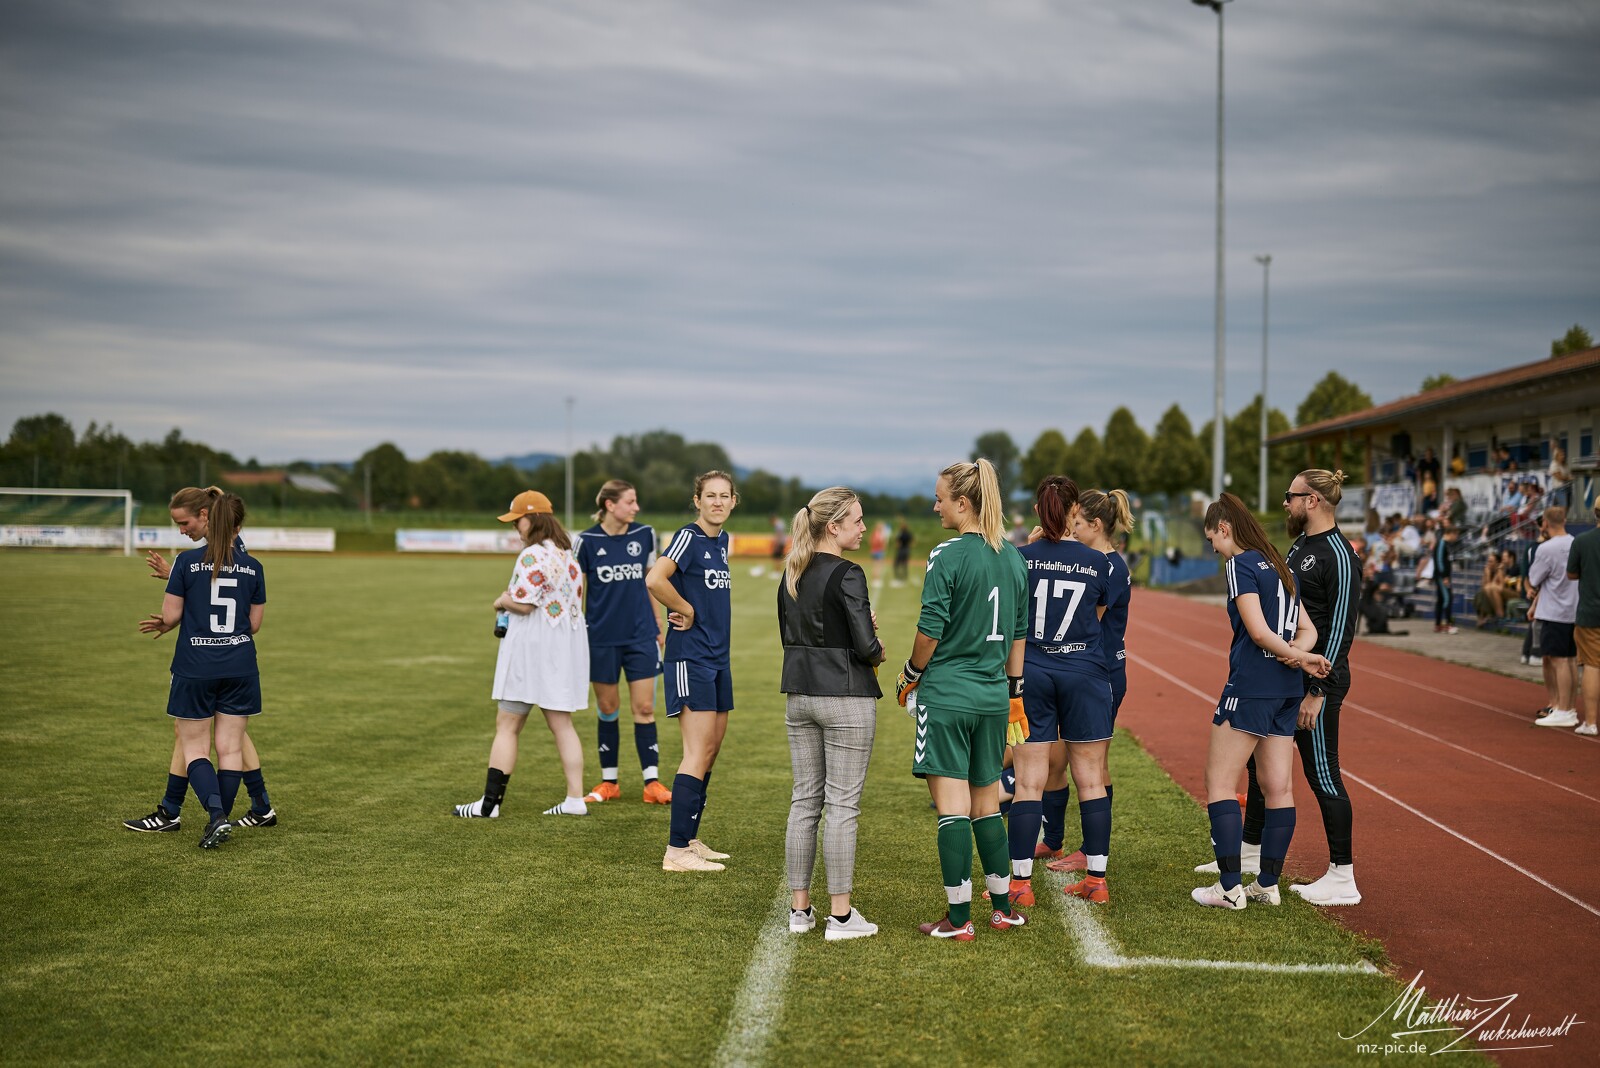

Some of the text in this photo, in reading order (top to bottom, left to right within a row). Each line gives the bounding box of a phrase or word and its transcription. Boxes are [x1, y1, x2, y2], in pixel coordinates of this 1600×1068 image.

[190, 563, 200, 573] SG
[613, 563, 642, 573] nova
[613, 571, 643, 581] GYM
[1035, 560, 1098, 578] Fridolfing/Laufen
[210, 578, 238, 633] 5
[985, 586, 1004, 642] 1
[1034, 579, 1086, 642] 17
[1277, 578, 1299, 641] 14
